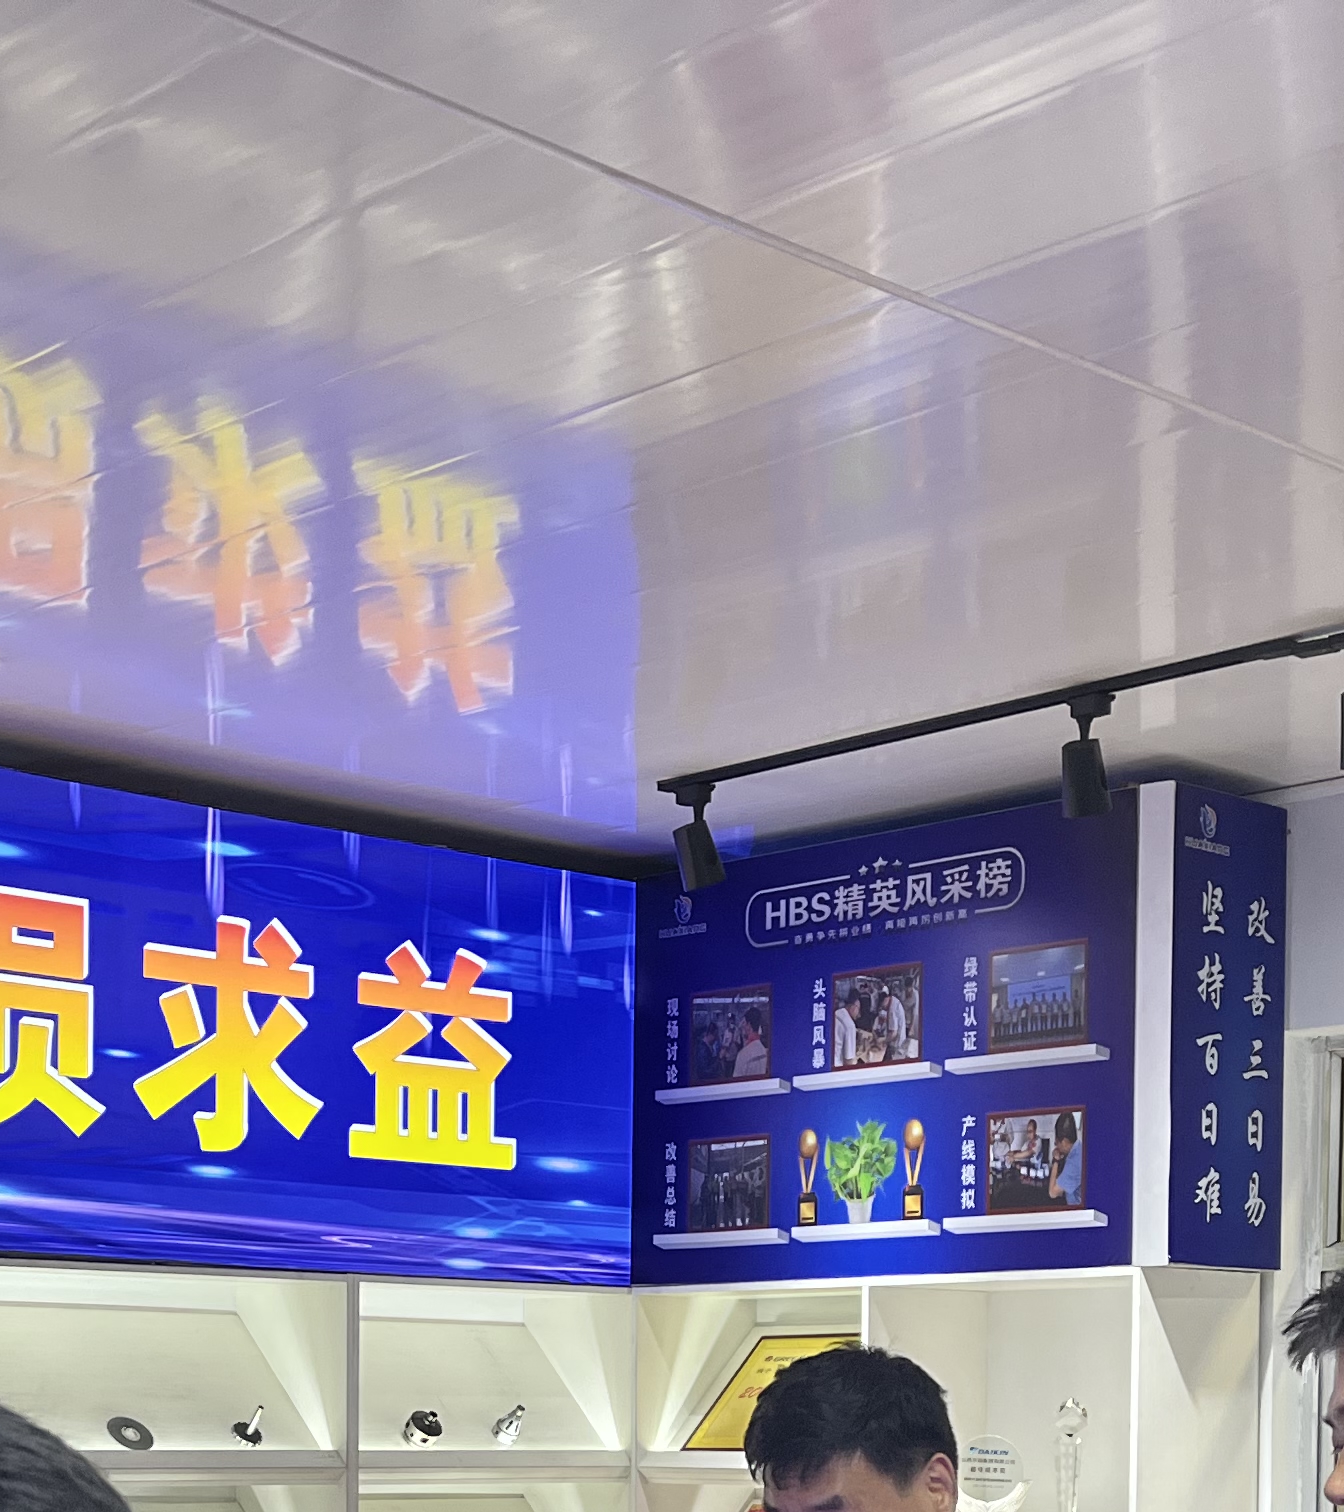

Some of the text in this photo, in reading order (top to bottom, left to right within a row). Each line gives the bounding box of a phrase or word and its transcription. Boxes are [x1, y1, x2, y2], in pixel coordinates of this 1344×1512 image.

[765, 858, 1013, 930] HBS精英风采榜
[666, 997, 680, 1083] 现场讨论
[812, 978, 826, 1068] 头脑风暴
[963, 956, 978, 1051] 绿带认证
[1194, 880, 1225, 1222] 坚持百日难
[1242, 896, 1275, 1227] 改善三日易
[664, 1142, 677, 1228] 改善总结
[961, 1115, 976, 1209] 产线模拟
